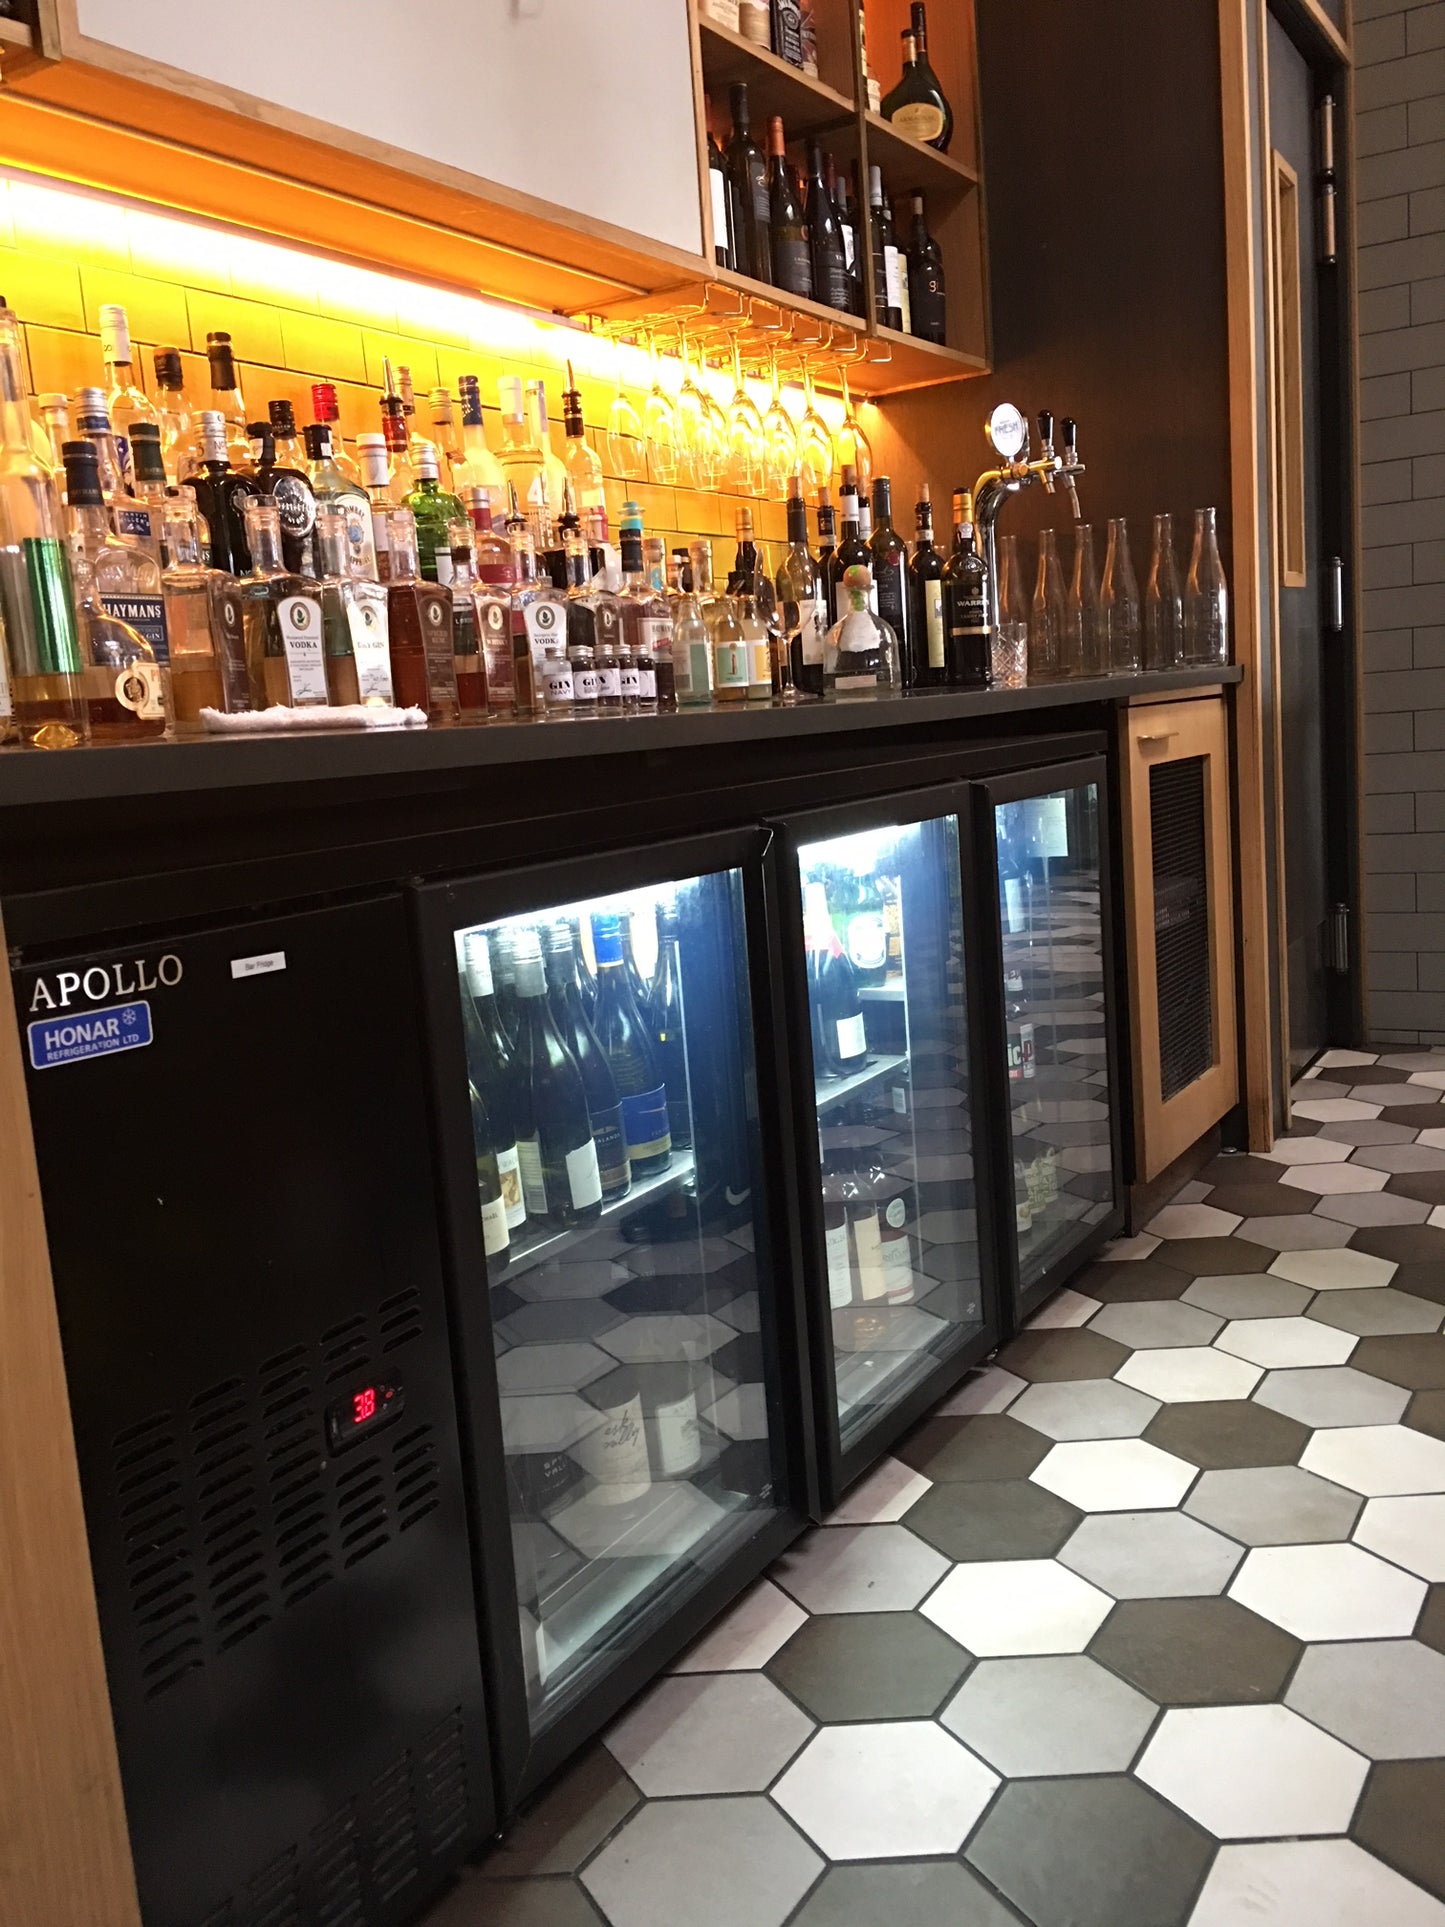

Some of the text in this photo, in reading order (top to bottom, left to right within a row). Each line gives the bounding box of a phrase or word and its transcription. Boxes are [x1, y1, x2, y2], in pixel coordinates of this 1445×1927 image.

[289, 641, 318, 649] VODKA
[29, 954, 184, 1012] APOLLO
[44, 1017, 120, 1050] HONAR
[46, 1032, 140, 1062] REFRIGERATION LTD
